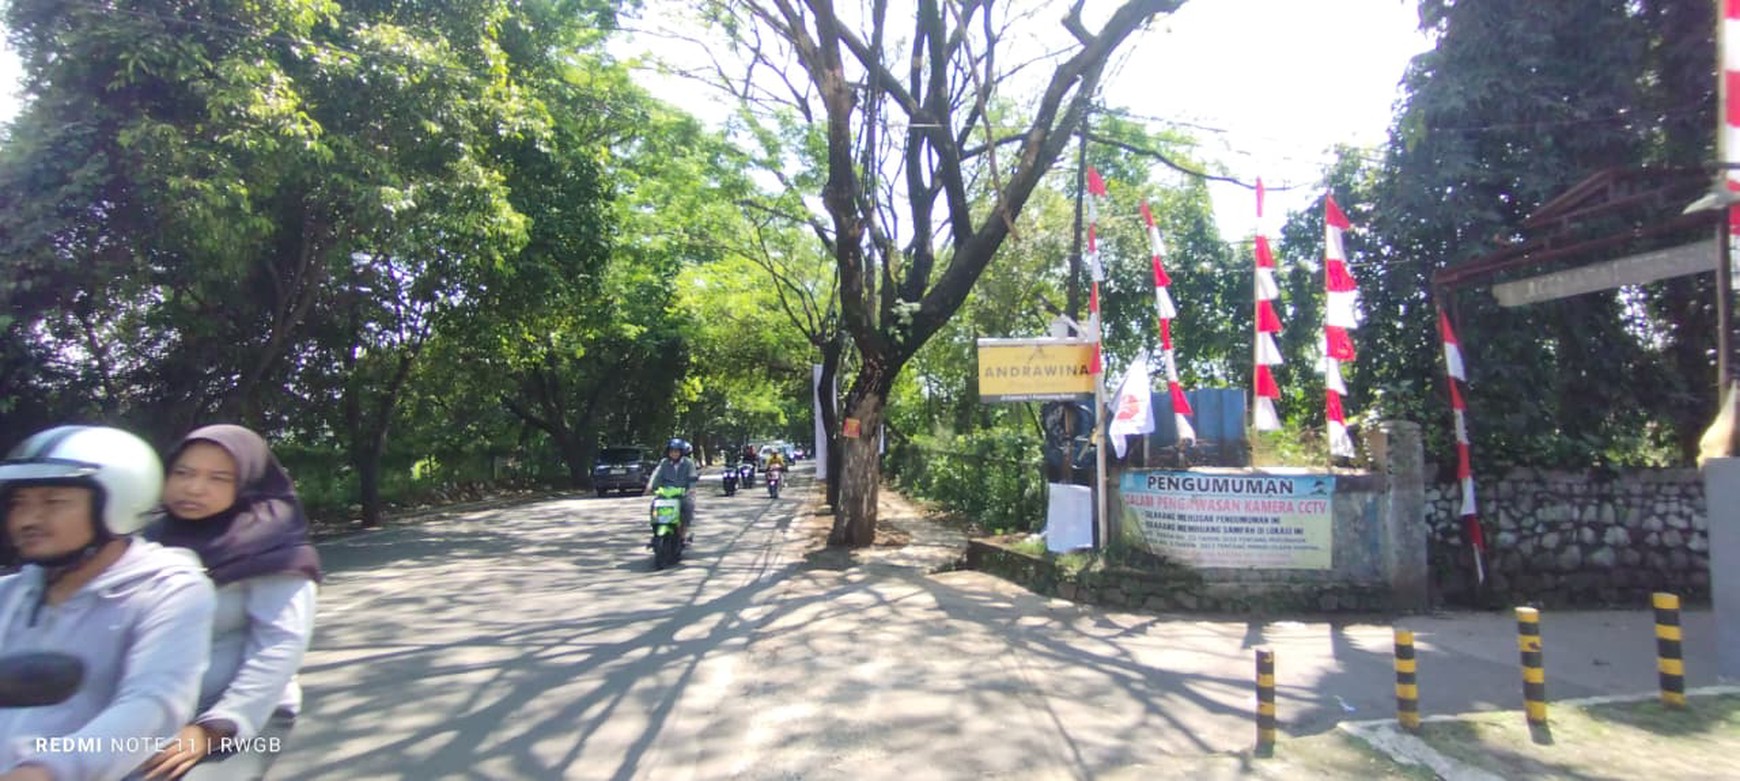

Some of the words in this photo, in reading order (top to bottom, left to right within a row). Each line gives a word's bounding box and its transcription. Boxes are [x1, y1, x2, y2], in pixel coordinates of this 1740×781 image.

[985, 364, 1089, 378] ANDRAWINA
[1147, 475, 1294, 495] PENGUMUMAN
[1156, 495, 1239, 513] PENGAWASAN
[1245, 499, 1294, 514] KAMERA
[1298, 501, 1328, 515] CCTV
